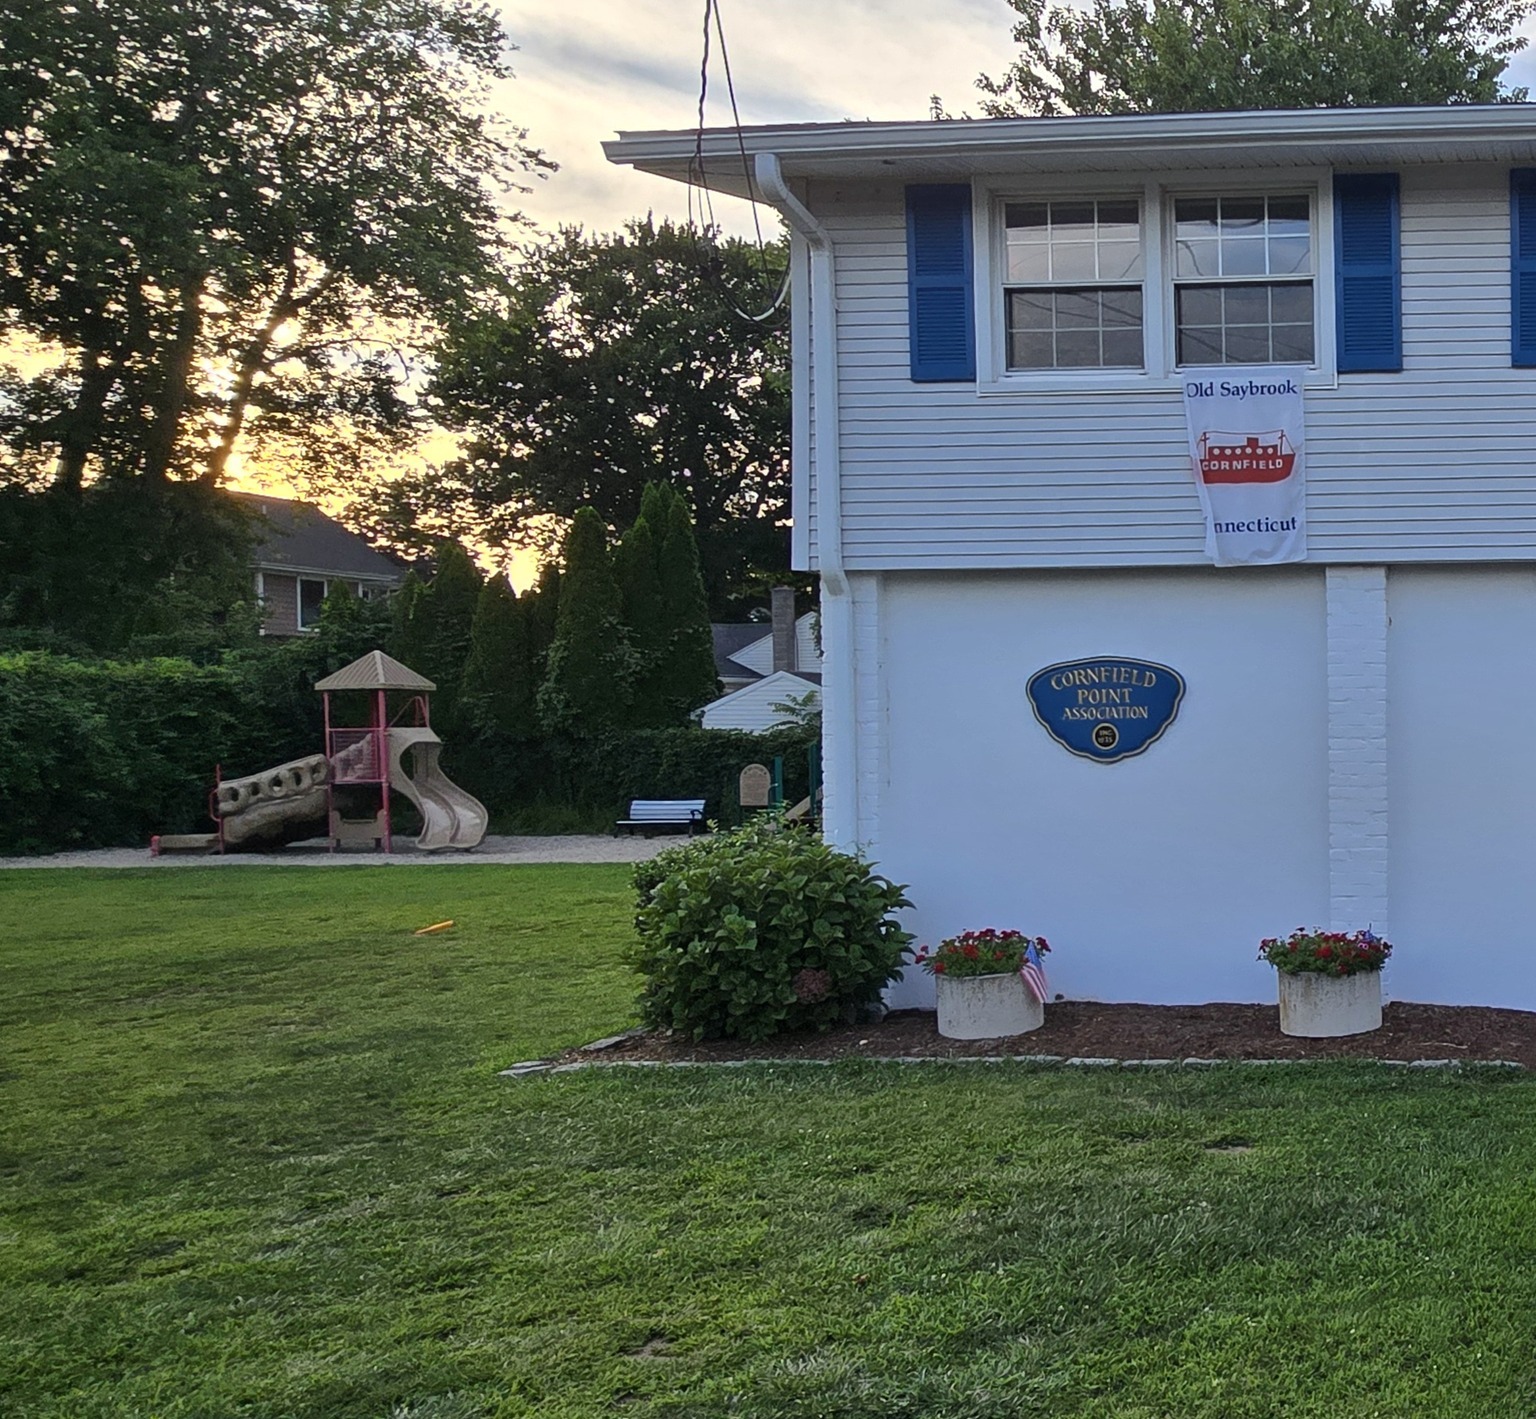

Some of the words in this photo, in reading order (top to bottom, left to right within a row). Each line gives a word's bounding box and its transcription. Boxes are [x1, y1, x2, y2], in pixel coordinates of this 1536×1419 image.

[1187, 382, 1214, 398] Old
[1220, 379, 1297, 400] Saybrook
[1202, 459, 1283, 471] CORNFIELD
[1213, 516, 1297, 533] nnecticut
[1051, 666, 1156, 690] CORNFIELD
[1077, 688, 1133, 705] POINT
[1062, 706, 1148, 720] ASSOCIATION
